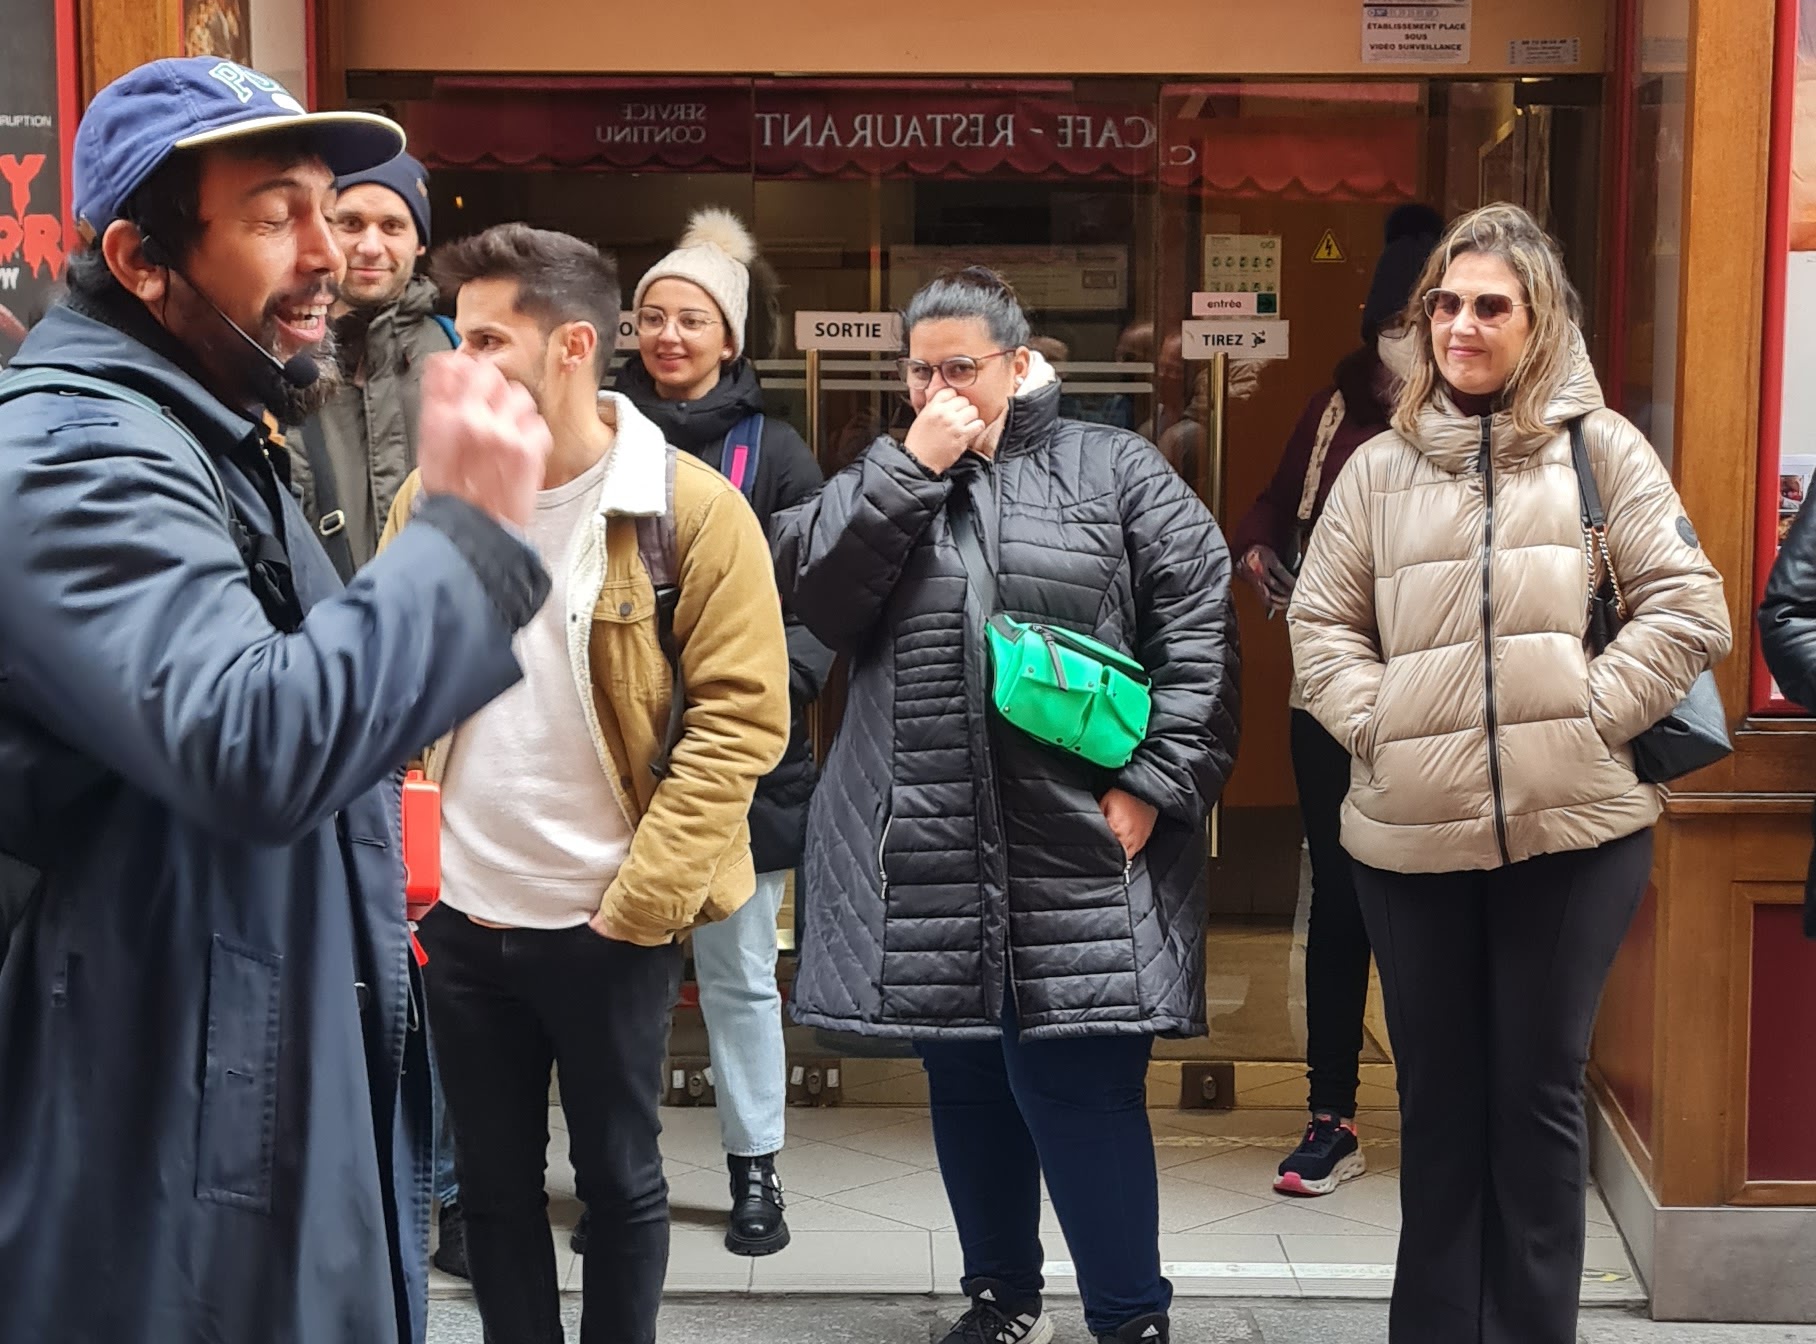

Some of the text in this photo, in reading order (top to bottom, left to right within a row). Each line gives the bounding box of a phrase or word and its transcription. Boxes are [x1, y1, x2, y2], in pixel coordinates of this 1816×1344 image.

[1404, 33, 1428, 41] SOUS
[1397, 43, 1463, 51] SURVEILLANCE
[1207, 298, 1242, 309] entrée
[814, 321, 882, 338] SORTIE
[1201, 333, 1244, 346] TIREZ
